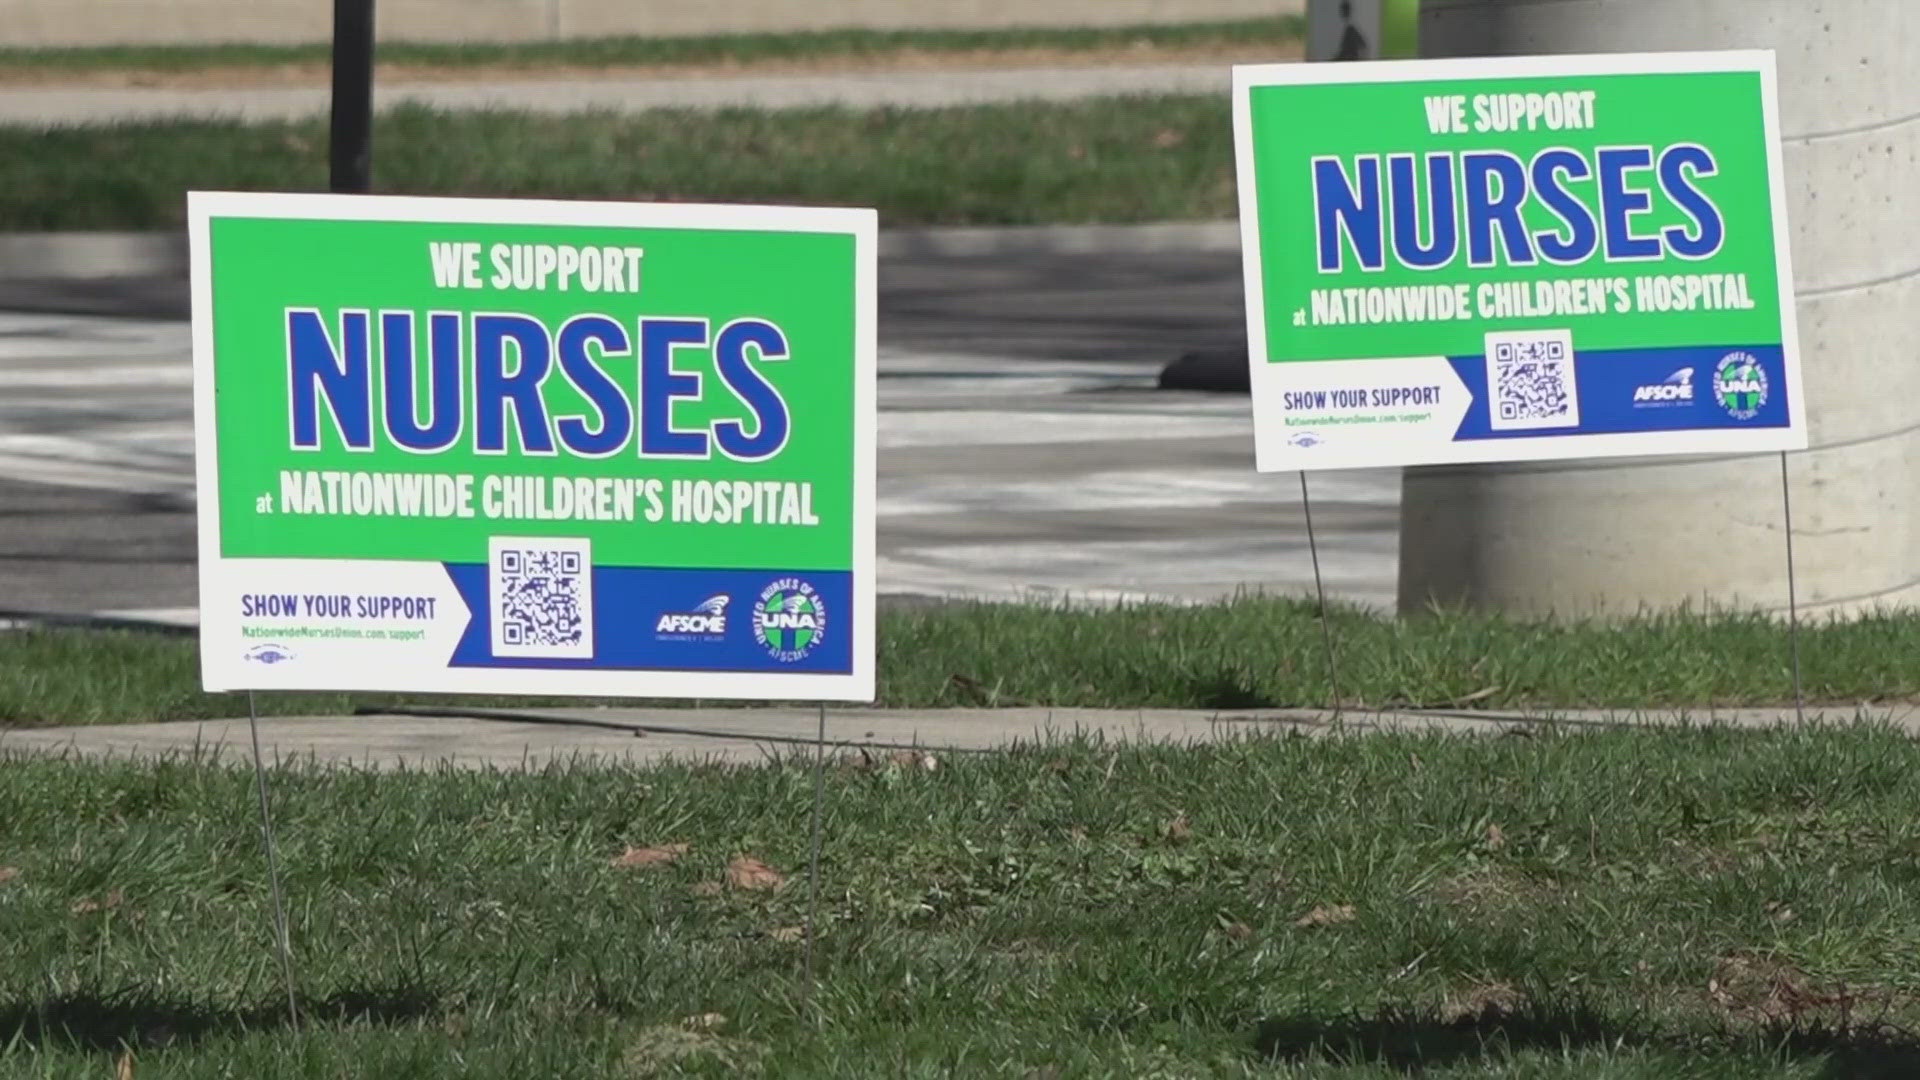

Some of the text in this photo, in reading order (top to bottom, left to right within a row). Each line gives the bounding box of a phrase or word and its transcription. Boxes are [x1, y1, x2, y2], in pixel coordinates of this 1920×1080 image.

[1424, 90, 1596, 135] WE SUPPORT
[1311, 143, 1725, 274] NURSES
[429, 241, 644, 293] WE SUPPORT
[1292, 274, 1755, 327] at NATIONWIDE CHILDREN'S HOSPITAL
[285, 307, 791, 462] NURSES
[1633, 384, 1692, 402] AFSCME
[1720, 379, 1761, 393] UNA
[1283, 386, 1441, 410] SHOW YOUR SUPPORT
[255, 470, 820, 526] at NATIONWIDE CHILDREN'S HOSPITAL
[760, 578, 799, 602] NURSES
[799, 580, 814, 595] OF
[242, 594, 437, 620] SHOW YOUR SUPPORT
[656, 614, 725, 633] AFSCME
[762, 613, 817, 629] UNA
